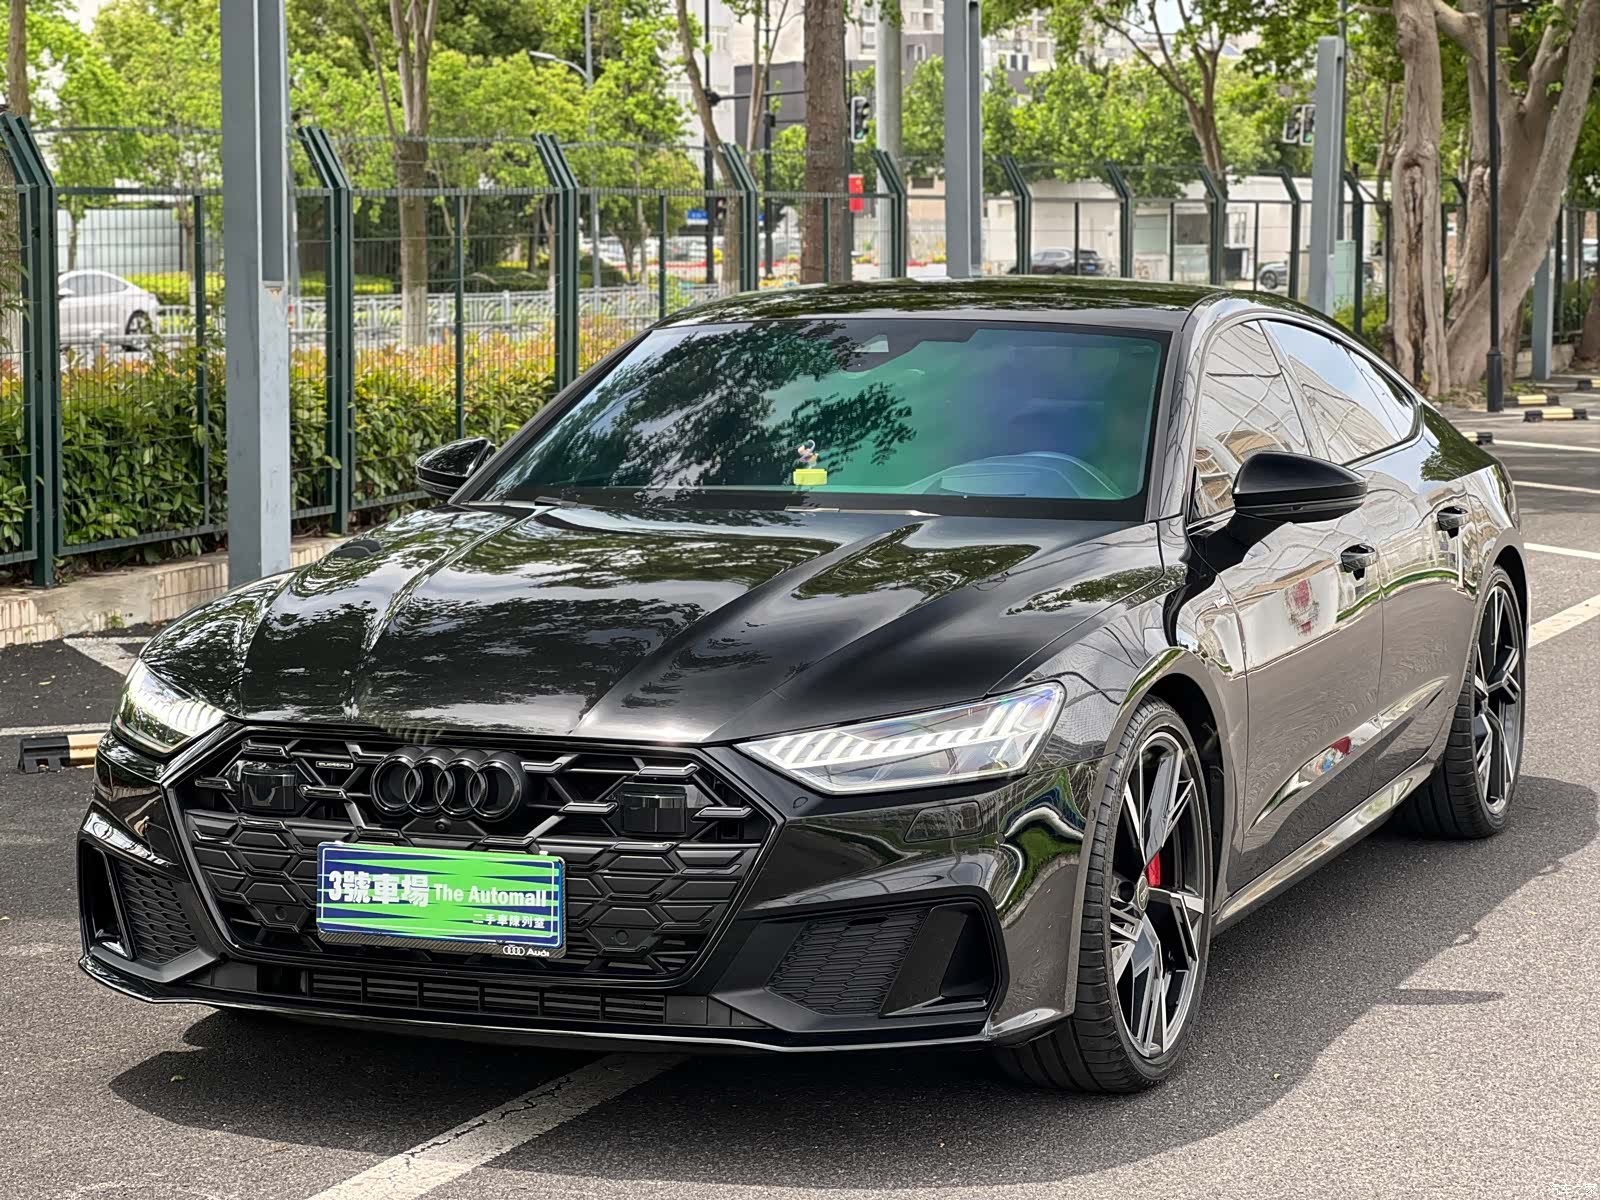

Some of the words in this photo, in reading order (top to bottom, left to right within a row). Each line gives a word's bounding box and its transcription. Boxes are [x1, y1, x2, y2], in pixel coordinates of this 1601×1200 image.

[328, 870, 429, 908] 3號車場
[434, 883, 464, 902] The
[468, 885, 547, 907] Automall
[472, 913, 545, 929] 二手車陳列室
[526, 948, 550, 957] Audi
